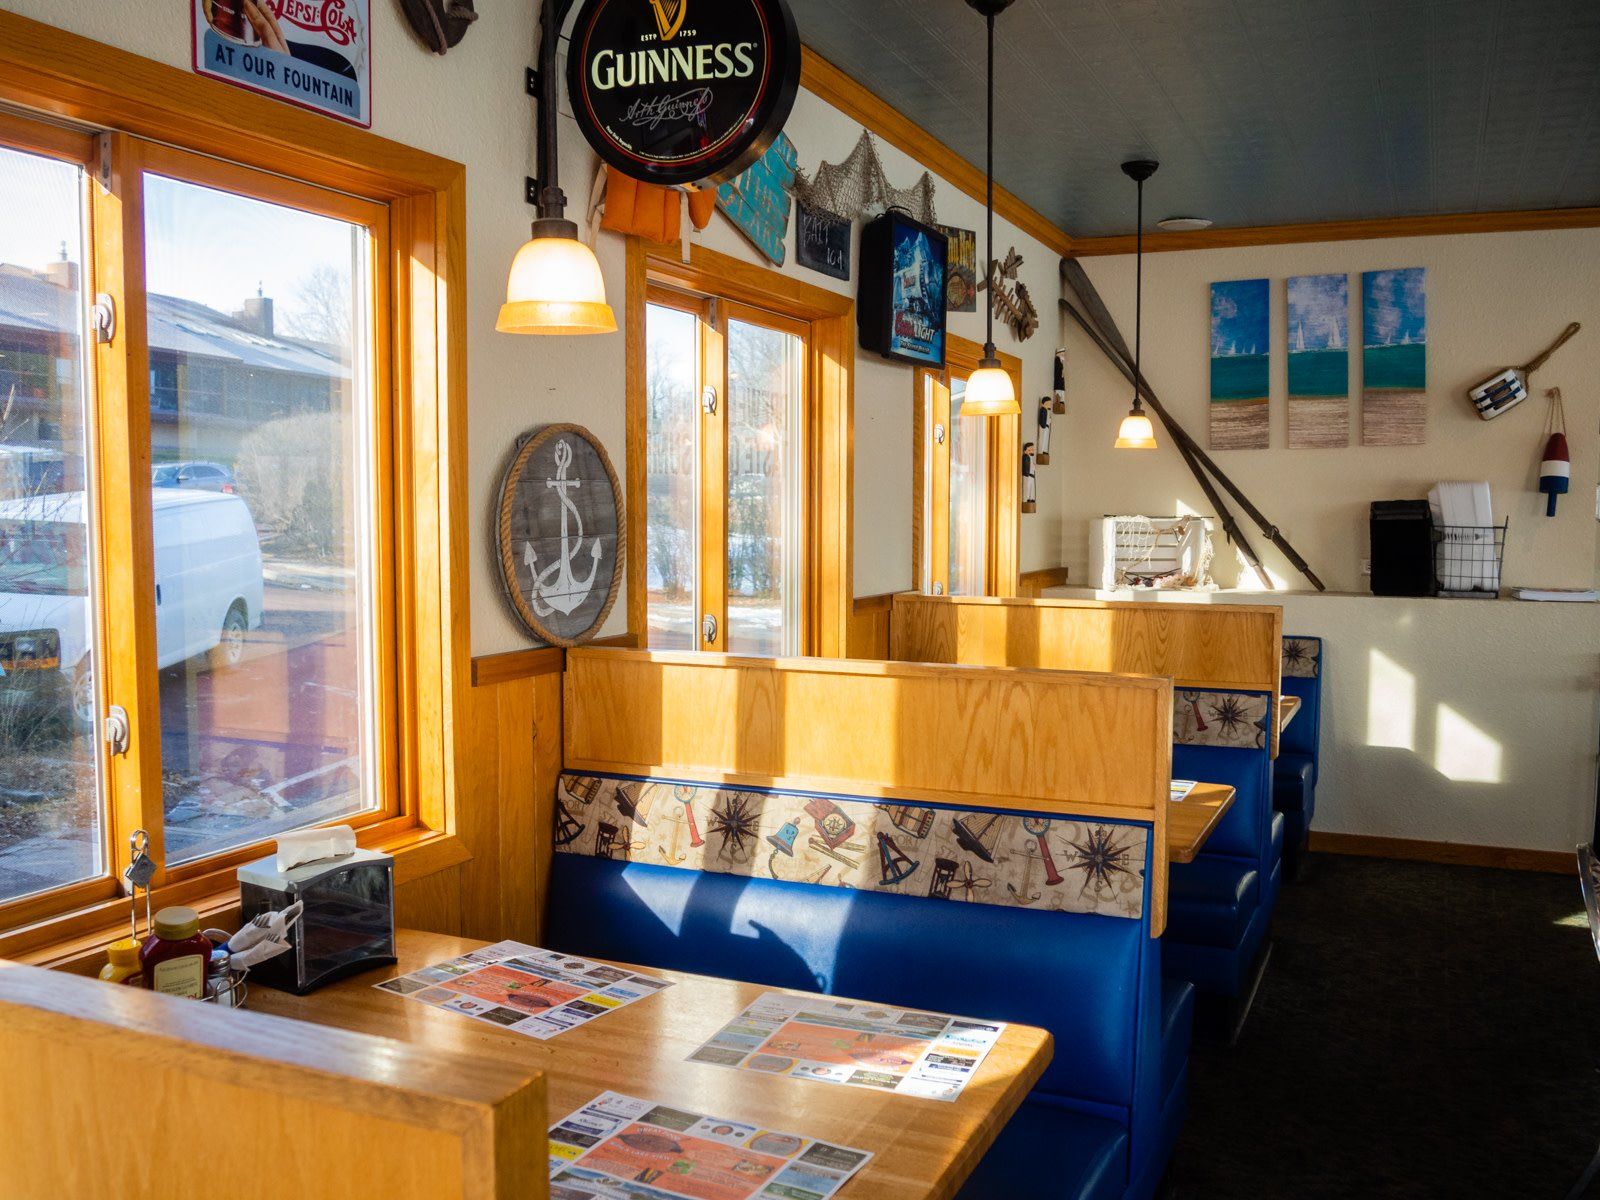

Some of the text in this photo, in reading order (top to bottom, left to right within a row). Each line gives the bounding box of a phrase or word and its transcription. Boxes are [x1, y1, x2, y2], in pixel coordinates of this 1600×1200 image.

[679, 29, 697, 37] 1759
[215, 43, 354, 108] AT OUR FOUNTAIN
[591, 42, 755, 91] GUINNESS
